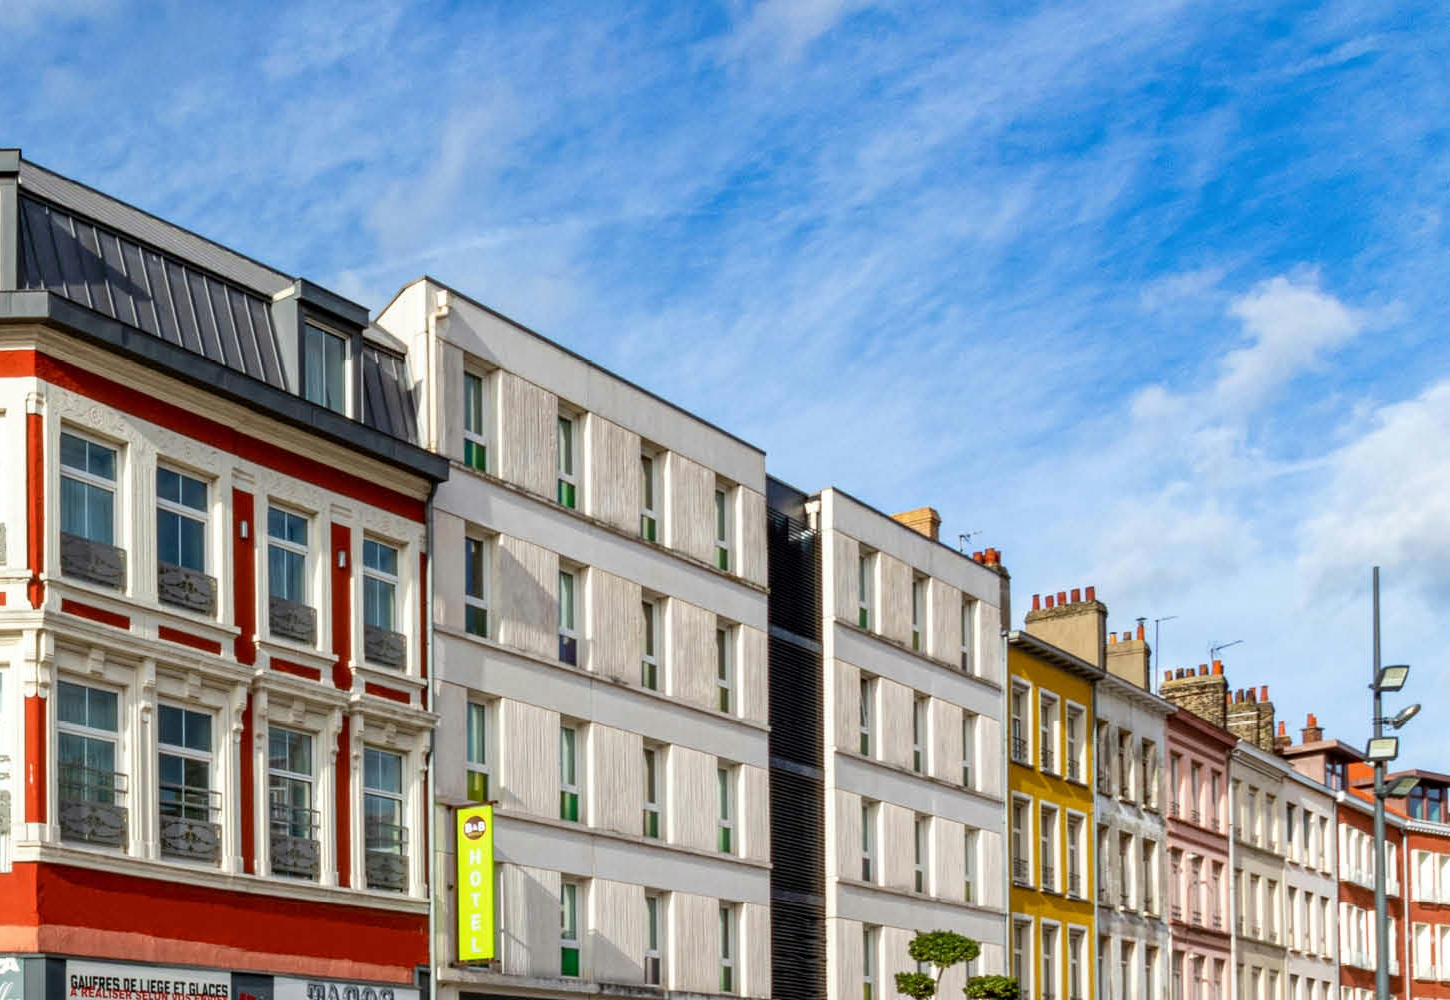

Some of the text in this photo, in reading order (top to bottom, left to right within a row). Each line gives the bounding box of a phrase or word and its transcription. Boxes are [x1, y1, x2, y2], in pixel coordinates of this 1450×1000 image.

[464, 821, 486, 833] B&B
[469, 848, 482, 953] HOTEL
[70, 975, 120, 991] GAUFRES
[123, 978, 136, 992] DE
[173, 981, 186, 995] ET
[189, 982, 228, 997] GLACES
